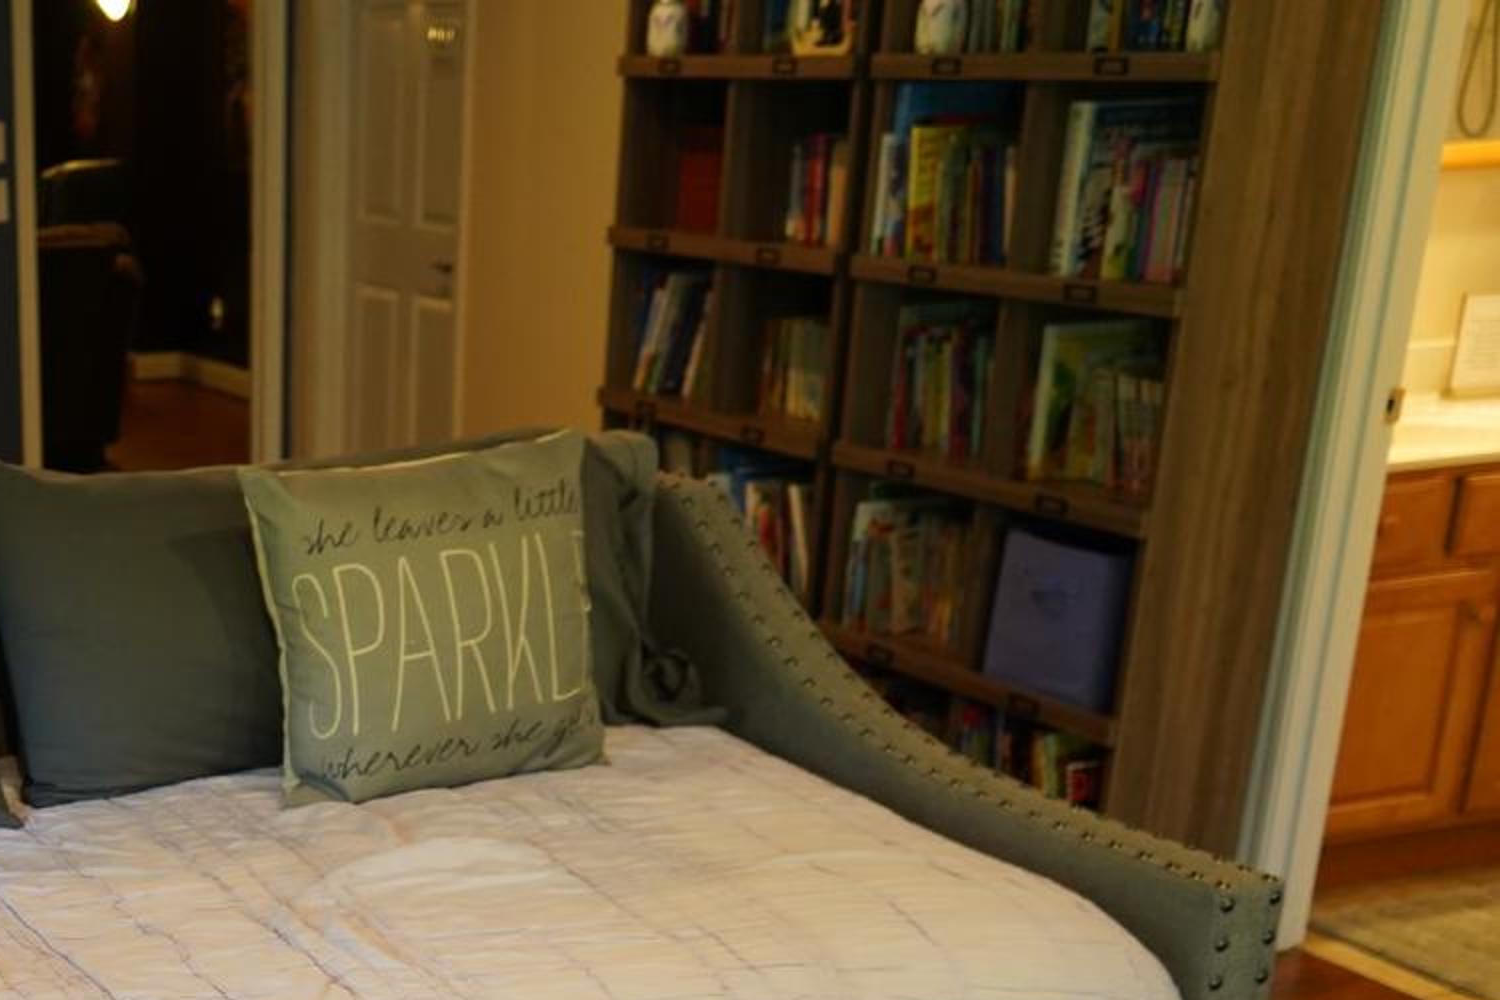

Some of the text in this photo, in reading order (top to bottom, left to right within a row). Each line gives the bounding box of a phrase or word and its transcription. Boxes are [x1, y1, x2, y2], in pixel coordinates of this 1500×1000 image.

[303, 517, 357, 555] she
[372, 505, 473, 543] leaves
[481, 507, 504, 529] a
[490, 716, 546, 750] she
